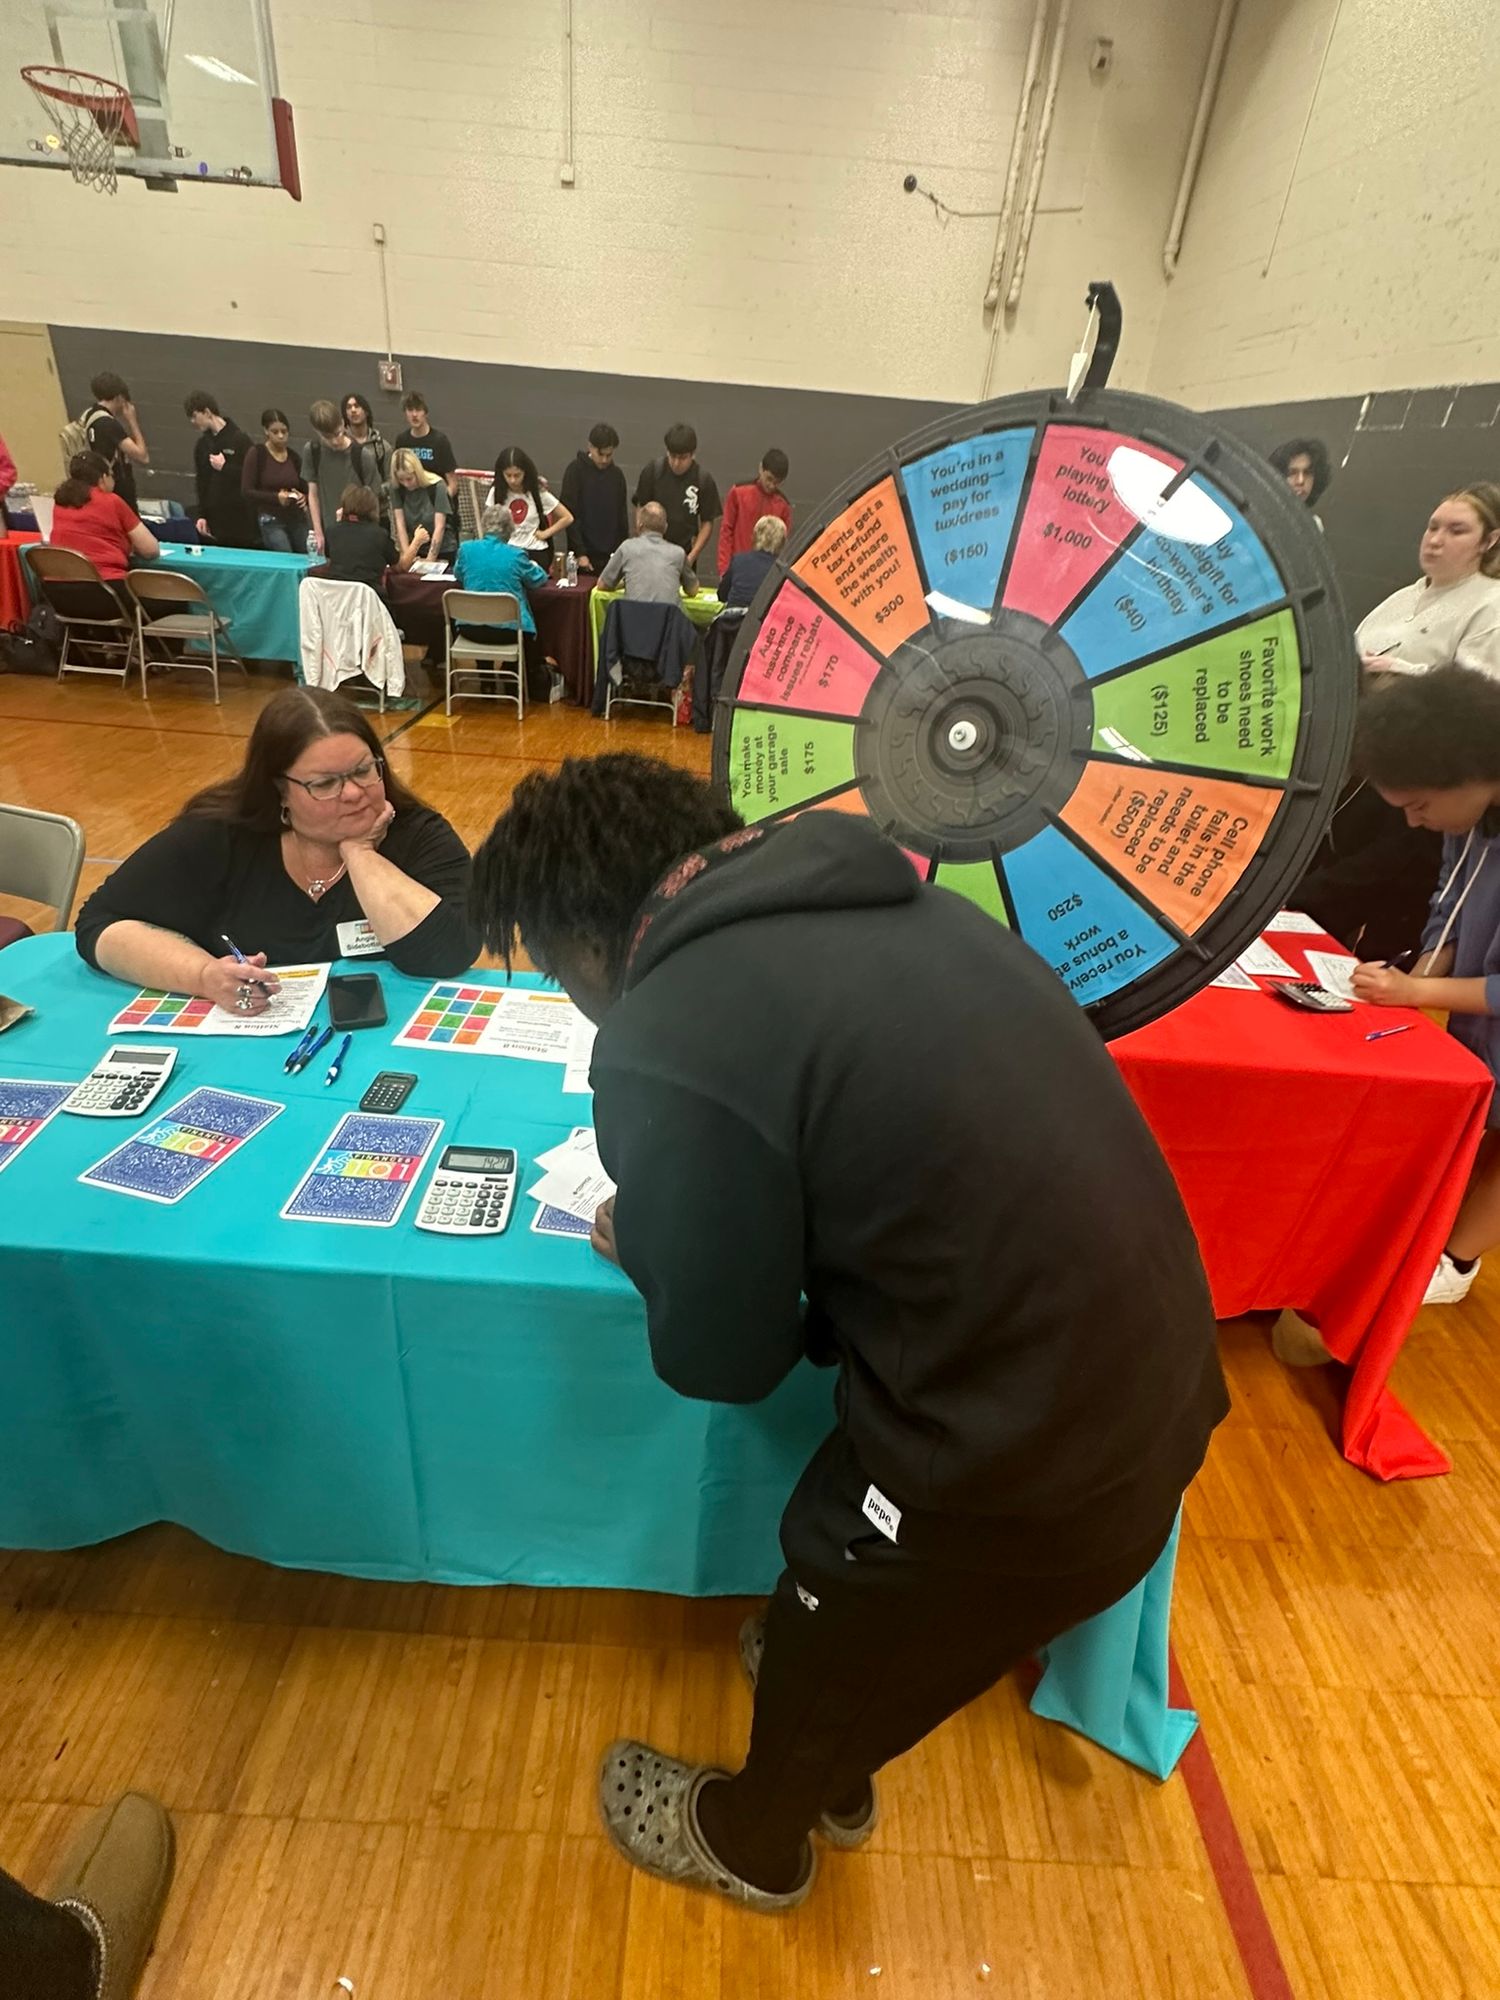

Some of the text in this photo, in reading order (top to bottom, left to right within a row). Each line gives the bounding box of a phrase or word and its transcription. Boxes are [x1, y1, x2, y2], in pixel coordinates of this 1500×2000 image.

[931, 450, 1004, 480] You're in a
[1055, 464, 1110, 492] playing
[1080, 446, 1106, 467] You
[935, 505, 1000, 532] tux/dress
[943, 490, 991, 515] pay for
[1063, 485, 1110, 514] lottery
[811, 499, 884, 569] Parents get a
[826, 518, 882, 574] tax refund
[944, 541, 988, 566] ($150)
[1043, 522, 1093, 549] $1,000
[835, 532, 889, 586] and share
[840, 543, 898, 599] the wealth
[850, 558, 902, 608] with you!
[1155, 535, 1215, 615] co-worker's
[875, 594, 905, 624] $300
[1146, 557, 1188, 616] birthday
[1218, 582, 1240, 607] for
[1113, 593, 1148, 633] ($40)
[759, 627, 777, 658] Auto
[763, 615, 795, 680] insurance
[777, 623, 807, 682] company
[780, 660, 804, 701] issues
[801, 615, 823, 658] rebate
[818, 654, 839, 688] $170
[1150, 684, 1168, 737] ($125)
[1192, 668, 1210, 743] replaced
[1216, 680, 1232, 724] to be
[1238, 649, 1255, 749] shoes need
[1260, 636, 1279, 757] Favorite work
[741, 736, 752, 799] You make
[754, 735, 766, 794] money at
[768, 724, 779, 803] your garage
[780, 748, 789, 776] sale
[804, 741, 816, 775] $175
[1110, 790, 1148, 839] ($500)
[1123, 788, 1169, 859] replaced
[1135, 786, 1193, 874] needs to be
[1157, 804, 1208, 876] toilet and
[1173, 808, 1229, 886] falls in the
[1190, 816, 1249, 897] Cell phone
[1047, 891, 1083, 922] $250
[1054, 929, 1129, 978] a bonus at
[1063, 924, 1102, 951] work
[1069, 943, 1147, 991] You receiv
[352, 1153, 414, 1164] FINANCES
[354, 1160, 410, 1180] 101
